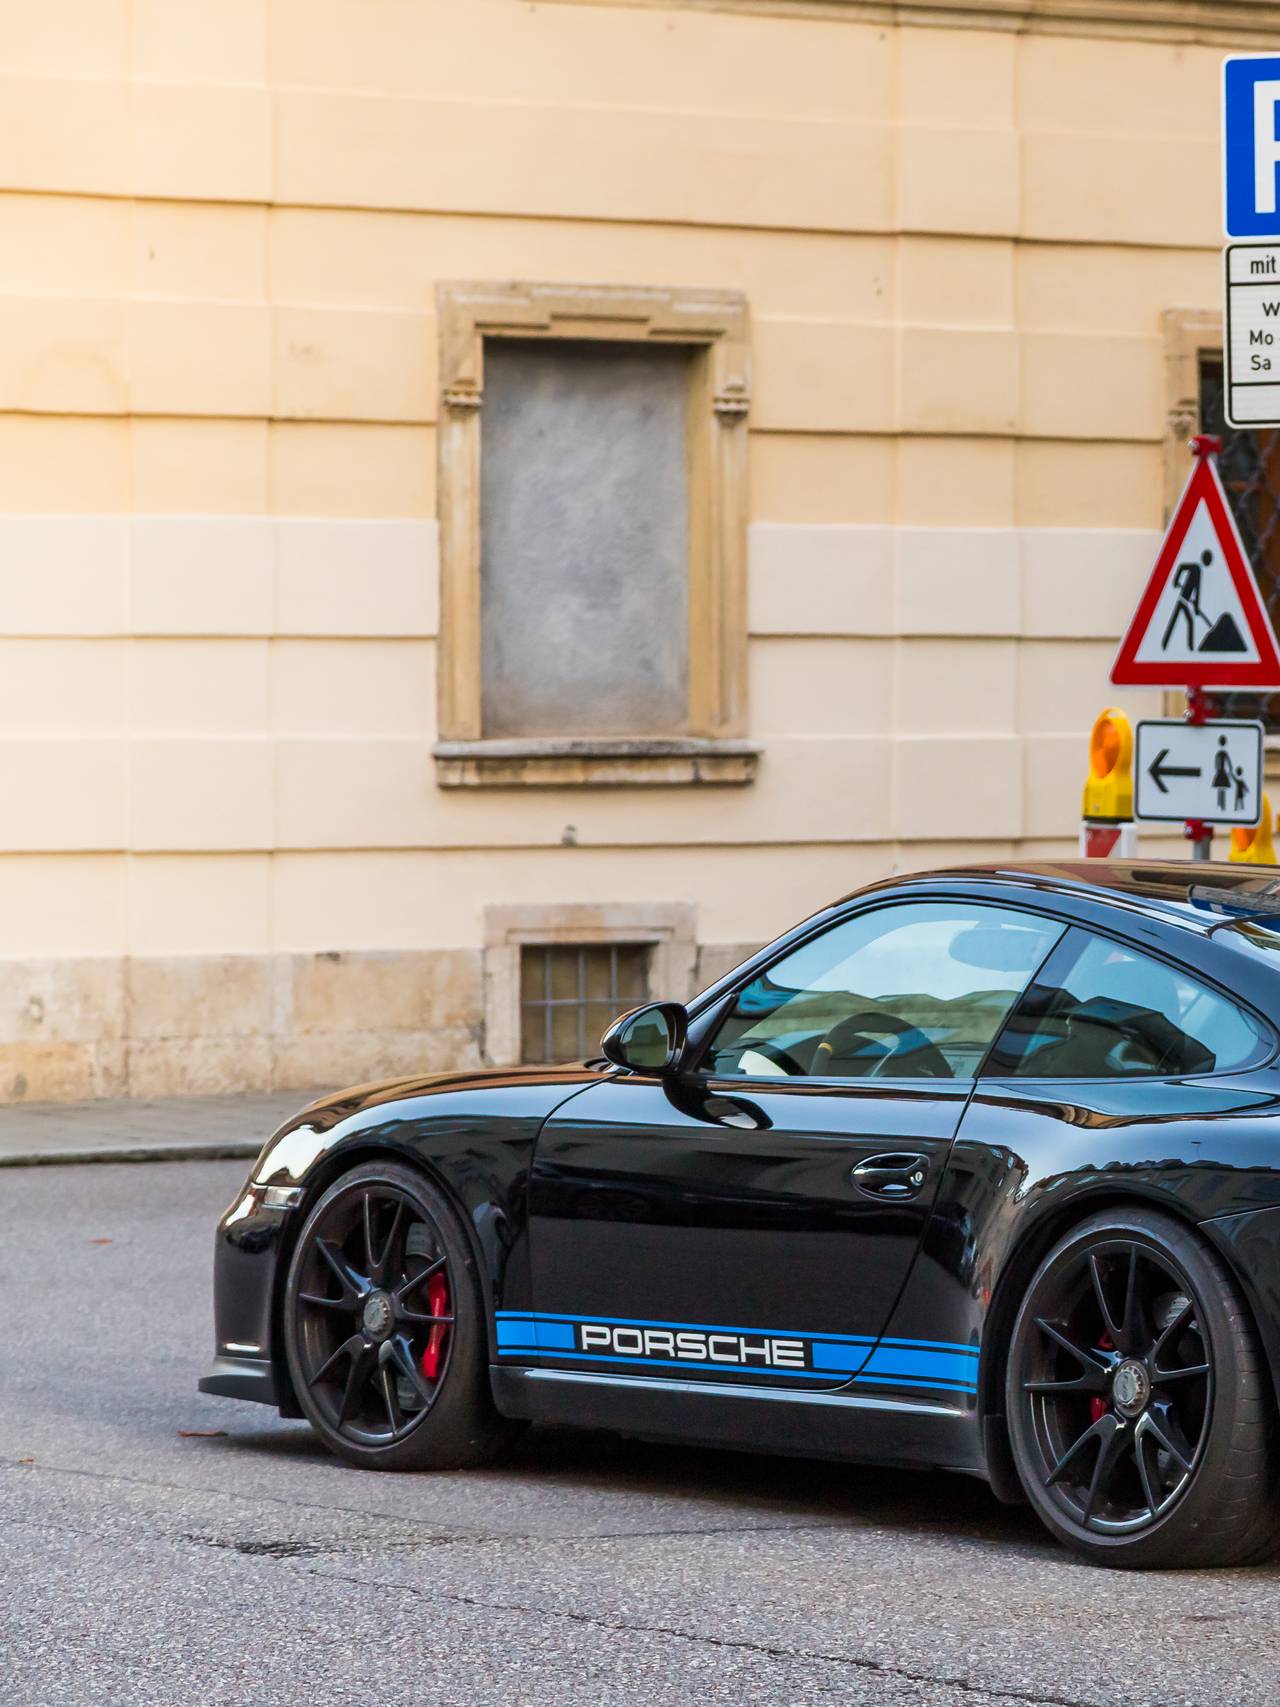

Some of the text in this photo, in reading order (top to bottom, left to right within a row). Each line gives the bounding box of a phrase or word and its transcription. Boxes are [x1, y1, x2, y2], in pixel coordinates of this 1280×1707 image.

[1250, 255, 1276, 274] mit
[1249, 329, 1274, 345] Mo
[1250, 355, 1272, 371] Sa
[580, 1324, 805, 1367] PORSCHE
